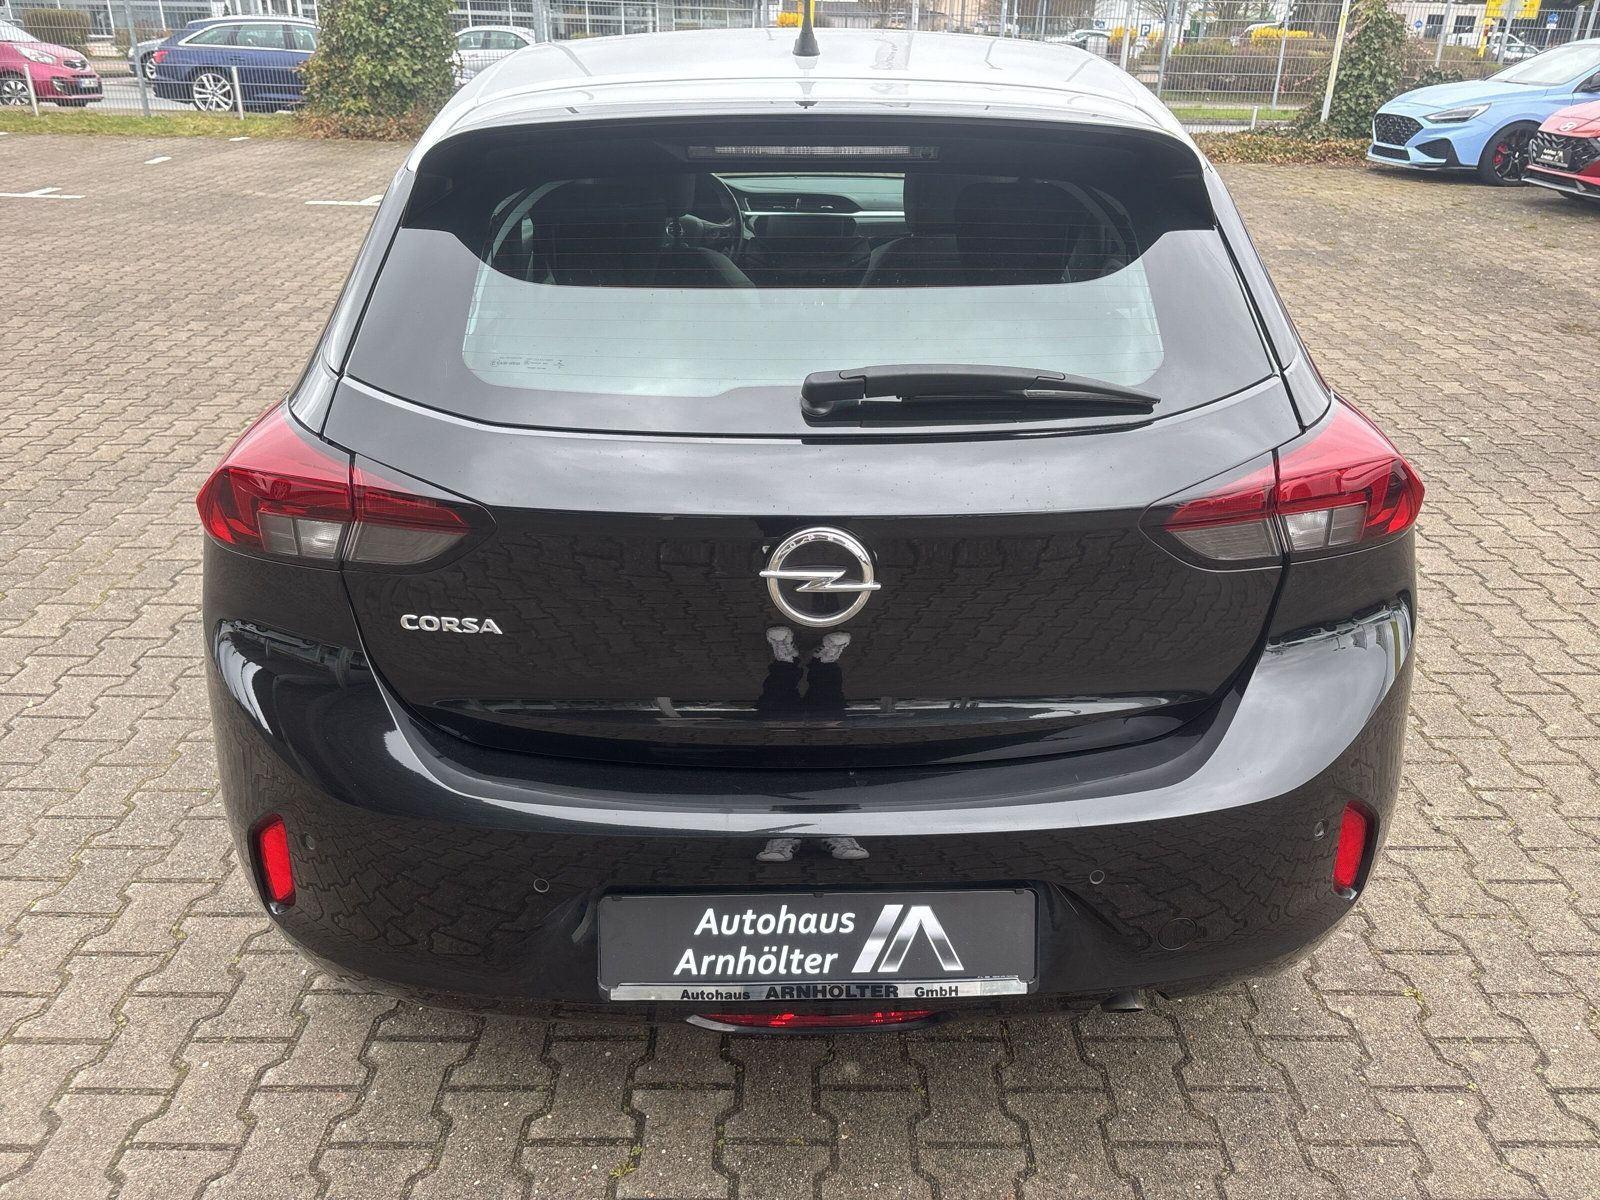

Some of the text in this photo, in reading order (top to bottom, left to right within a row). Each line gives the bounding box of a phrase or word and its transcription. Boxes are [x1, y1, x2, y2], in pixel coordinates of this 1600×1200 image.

[1141, 25, 1151, 36] P
[400, 614, 503, 635] CORSA
[694, 904, 855, 936] Autohaus
[673, 945, 838, 976] Arnhölter
[680, 984, 960, 1000] Autohaus ARNHÖLTER GmbH
